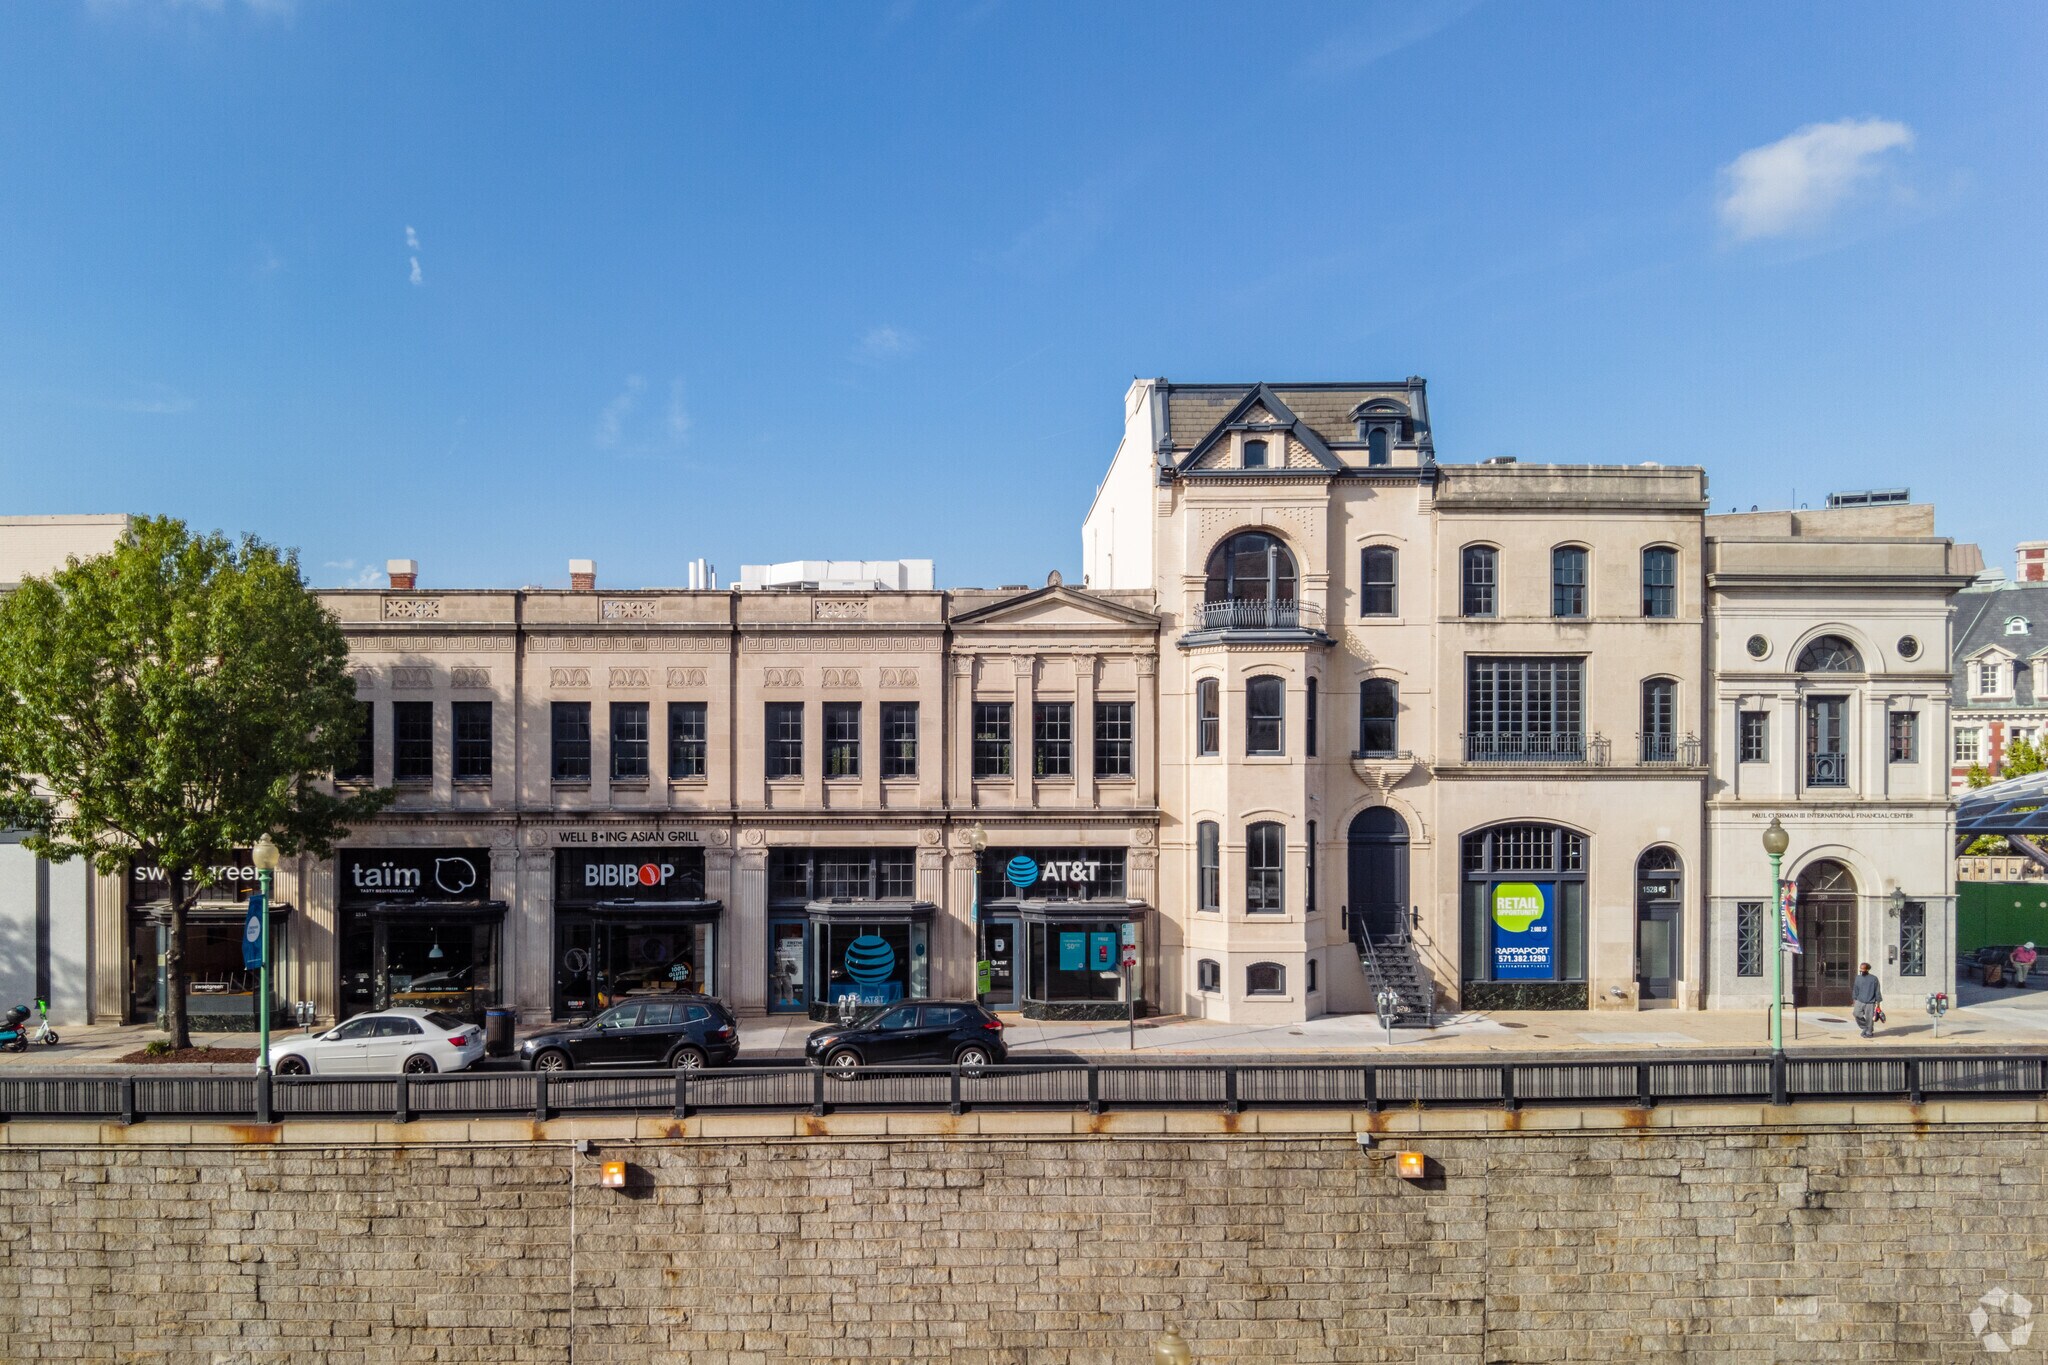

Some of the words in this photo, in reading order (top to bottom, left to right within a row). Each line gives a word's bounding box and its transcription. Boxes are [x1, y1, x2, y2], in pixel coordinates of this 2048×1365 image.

[559, 832, 588, 842] WELL
[631, 832, 664, 841] ASIAN
[668, 832, 699, 841] GRILL
[352, 862, 420, 886] taïm
[585, 864, 675, 886] BIBIBOP
[1041, 861, 1100, 882] AT&T
[1497, 897, 1538, 909] RETAIL
[864, 996, 884, 1004] AT&T
